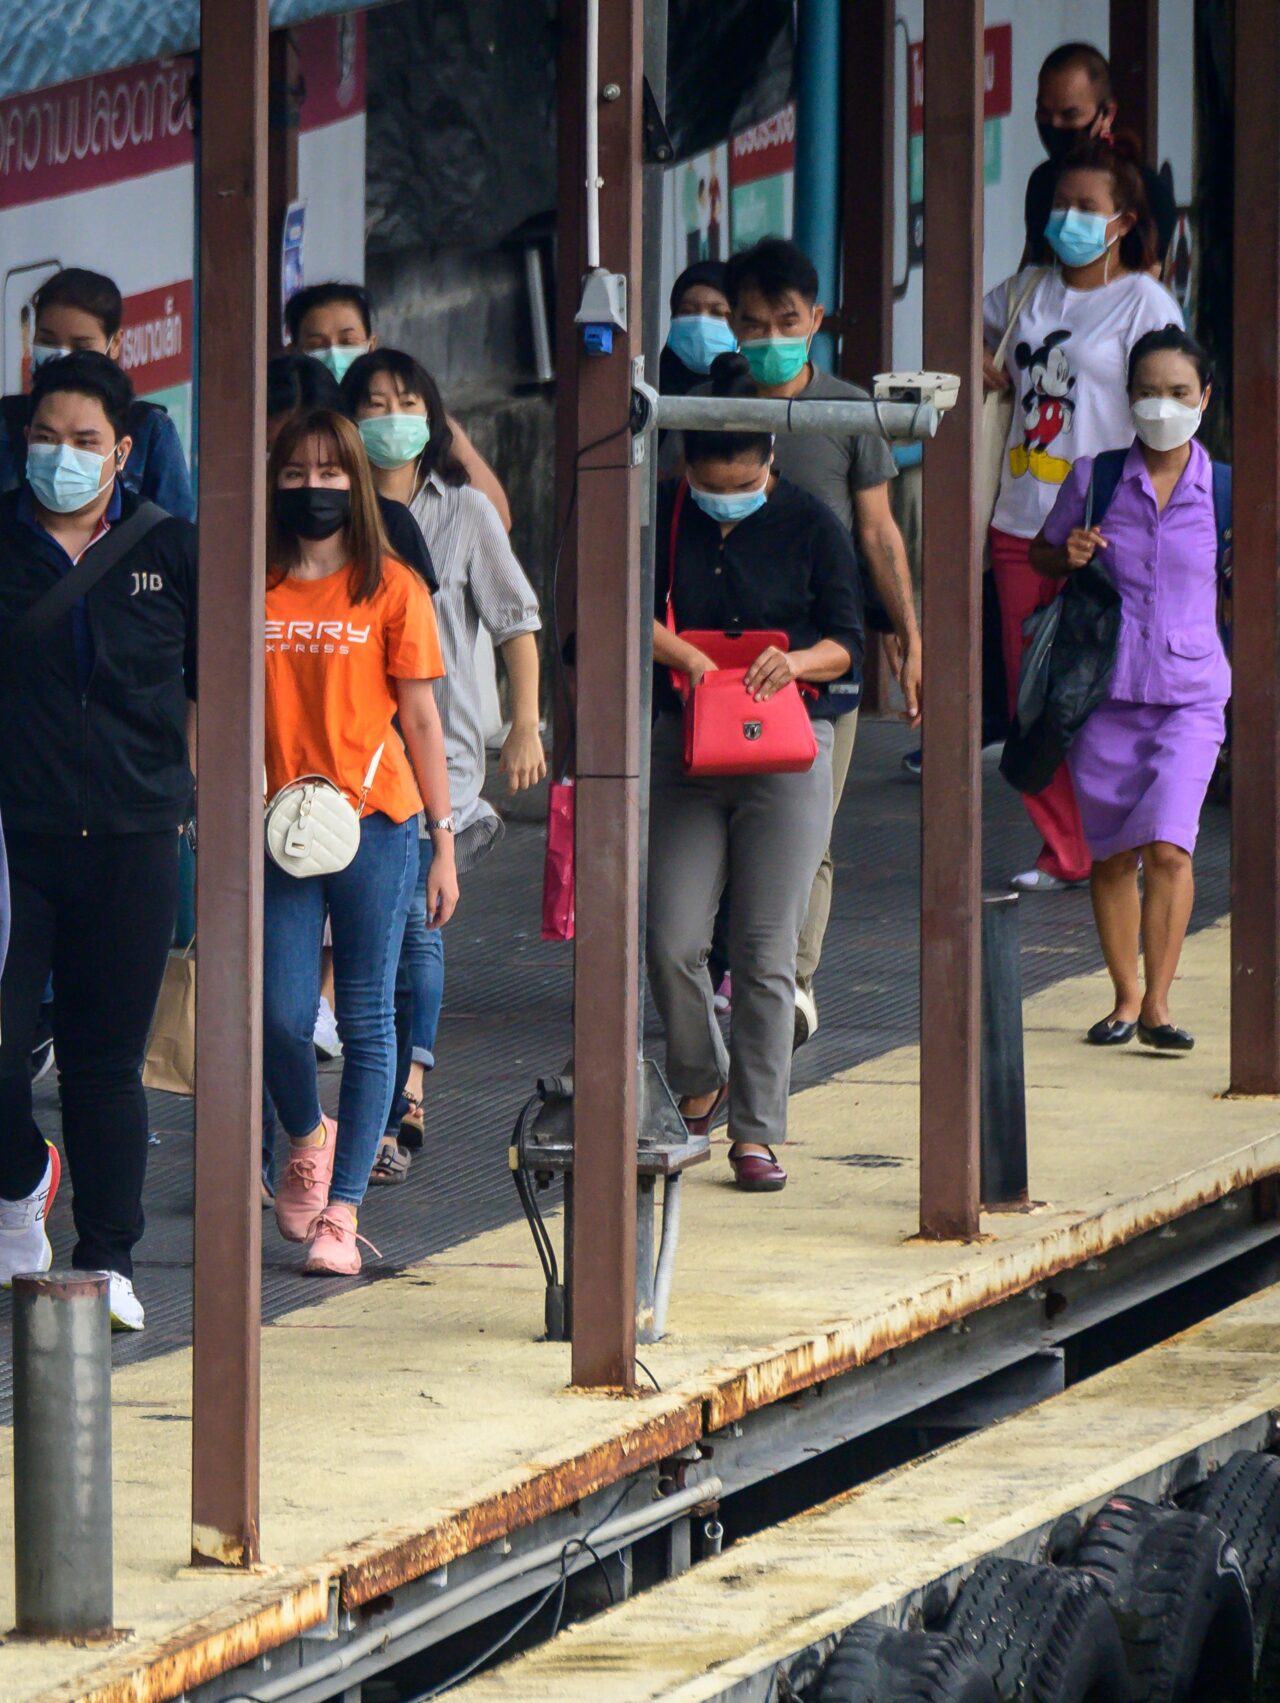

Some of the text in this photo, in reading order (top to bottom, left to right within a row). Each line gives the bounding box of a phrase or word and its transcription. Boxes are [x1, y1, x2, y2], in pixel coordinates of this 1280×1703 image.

[130, 571, 163, 596] JIB
[265, 621, 370, 643] ERRY
[265, 644, 350, 655] XPRESS
